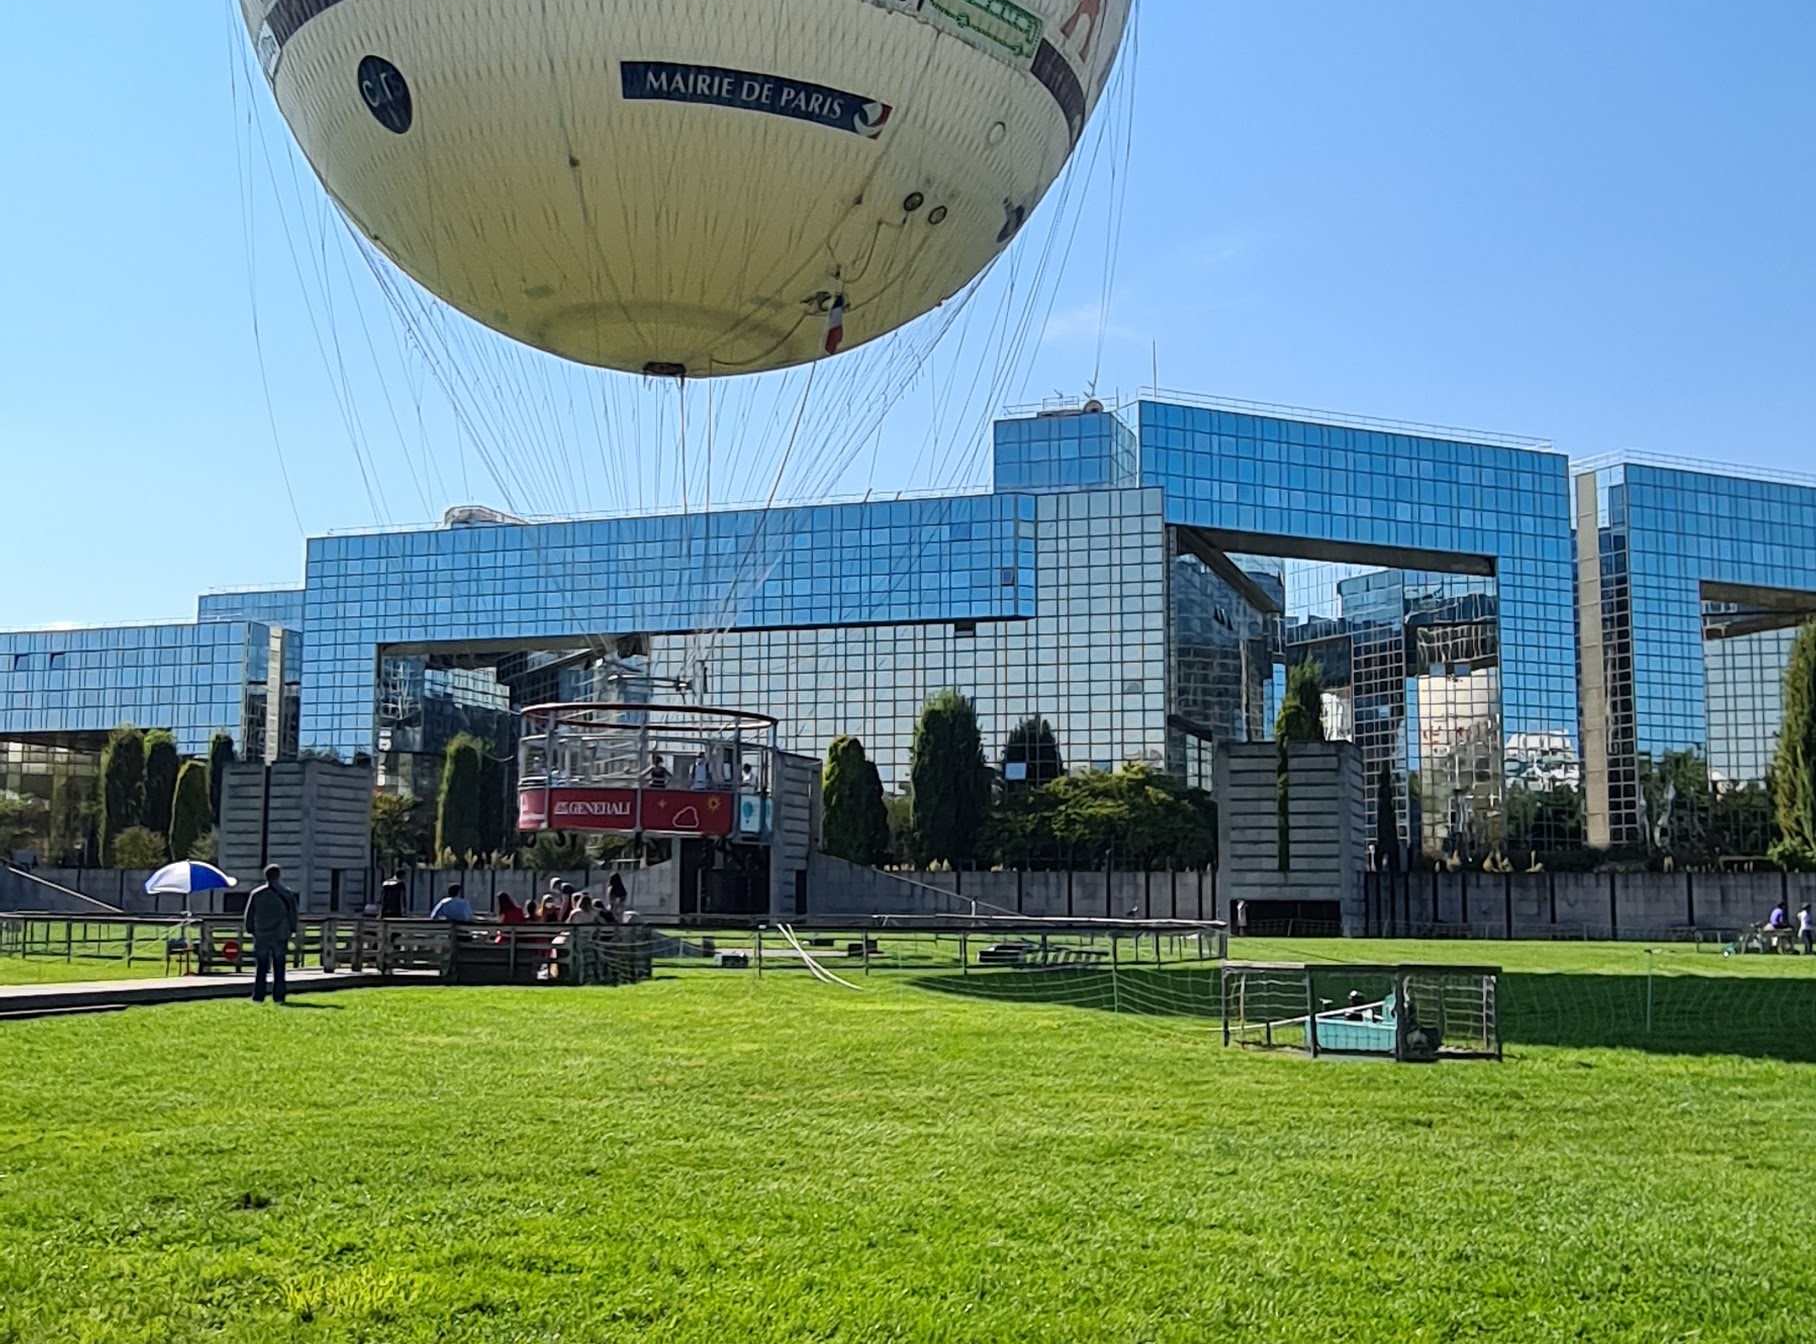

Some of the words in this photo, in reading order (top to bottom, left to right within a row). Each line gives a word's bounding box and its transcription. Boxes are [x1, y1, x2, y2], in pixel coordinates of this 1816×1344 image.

[645, 70, 735, 99] MAIRIE
[740, 80, 774, 105] DE
[780, 86, 845, 121] PARIS
[569, 800, 632, 816] GENERALI
